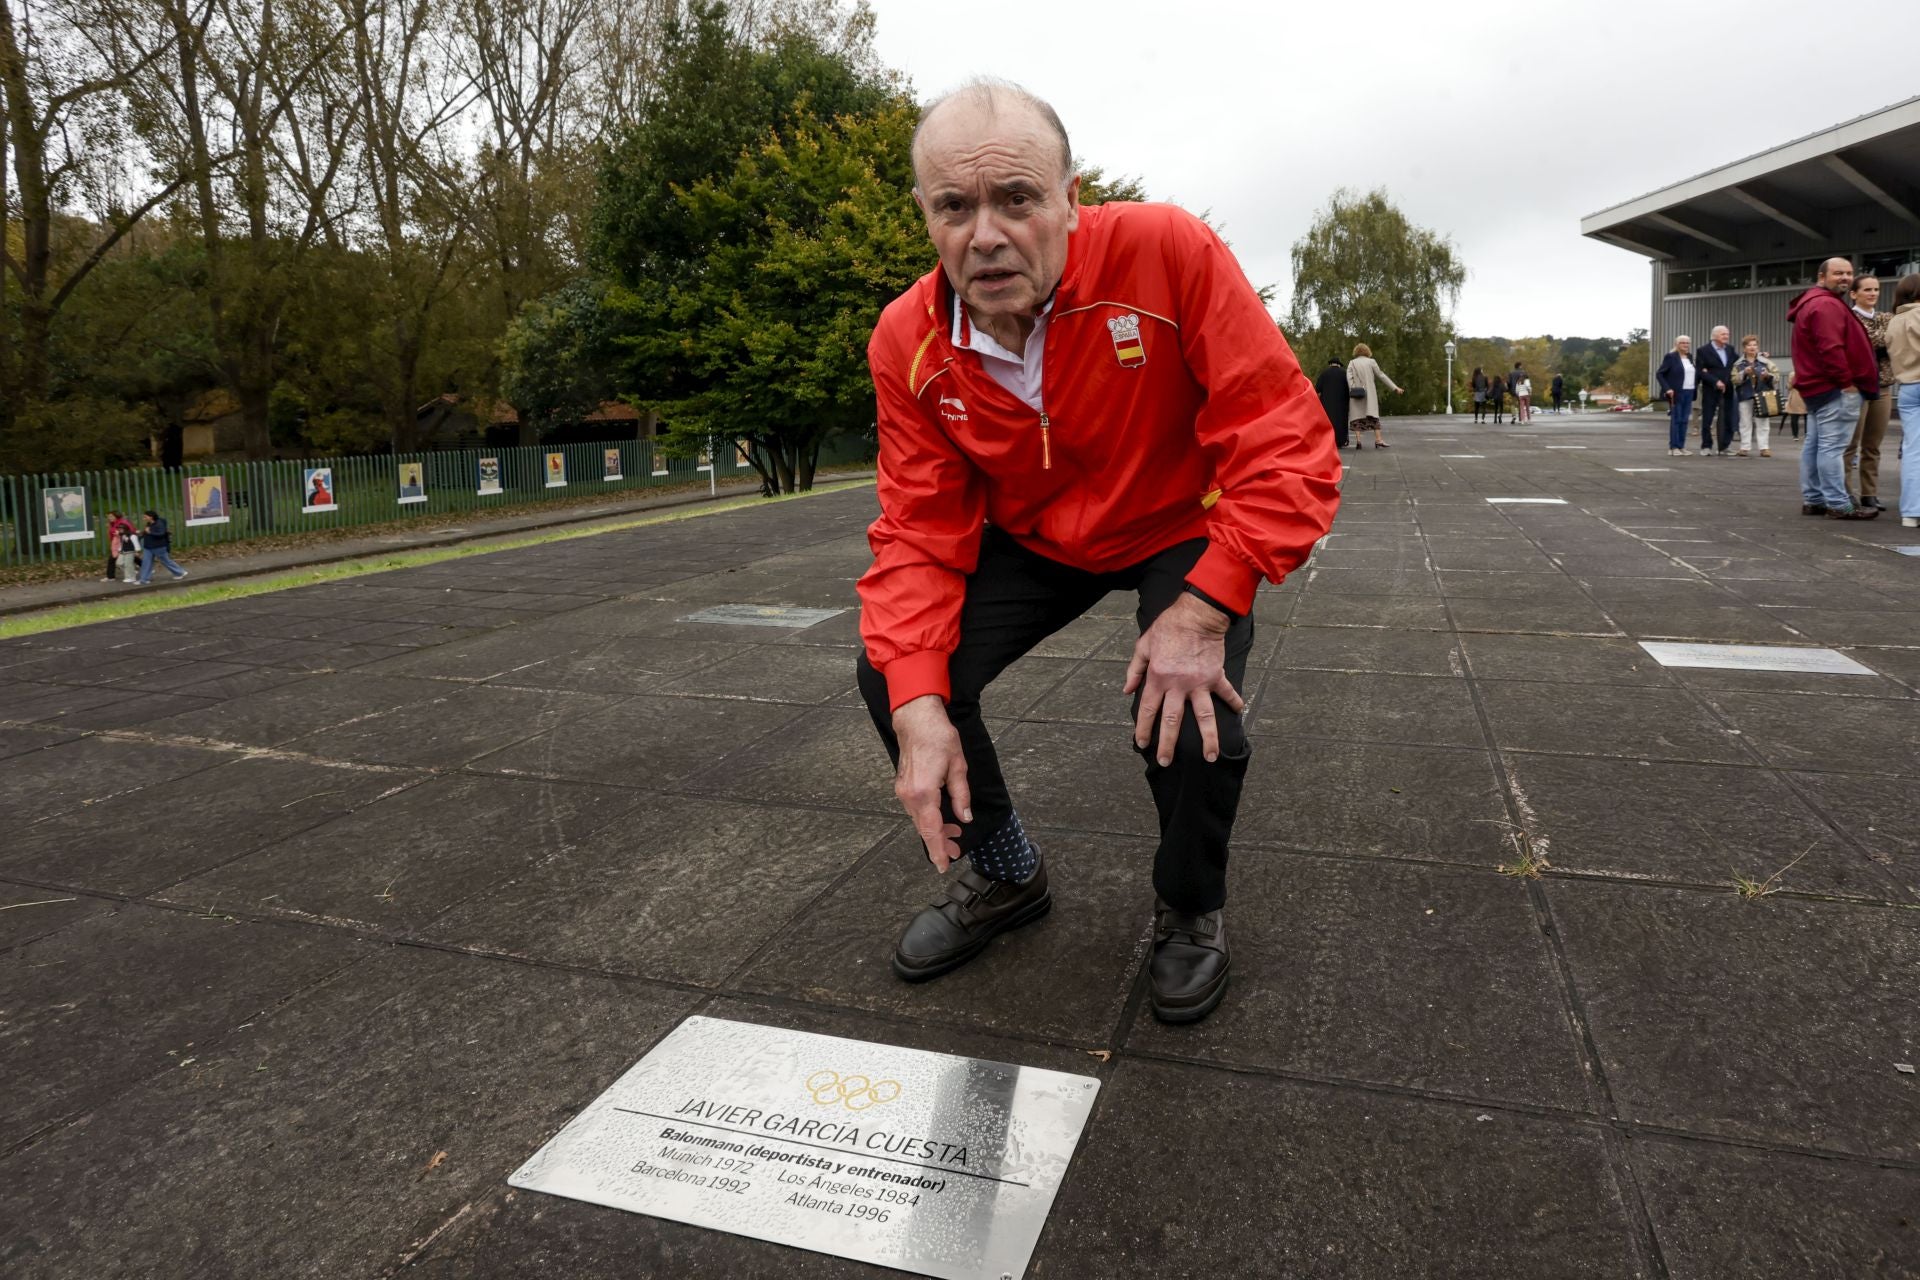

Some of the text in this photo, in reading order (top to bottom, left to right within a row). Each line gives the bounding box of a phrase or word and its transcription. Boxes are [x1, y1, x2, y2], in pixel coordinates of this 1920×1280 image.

[674, 1098, 968, 1166] JAVIER GARCÍA CUESTA
[630, 1160, 751, 1195] Barcelona 1992
[657, 1146, 754, 1175] Munich 1972
[659, 1127, 946, 1194] Balonmano (deportista y entrenador)
[777, 1169, 920, 1208] Los Ángeles 1984
[784, 1191, 891, 1223] Atlanta 1996
